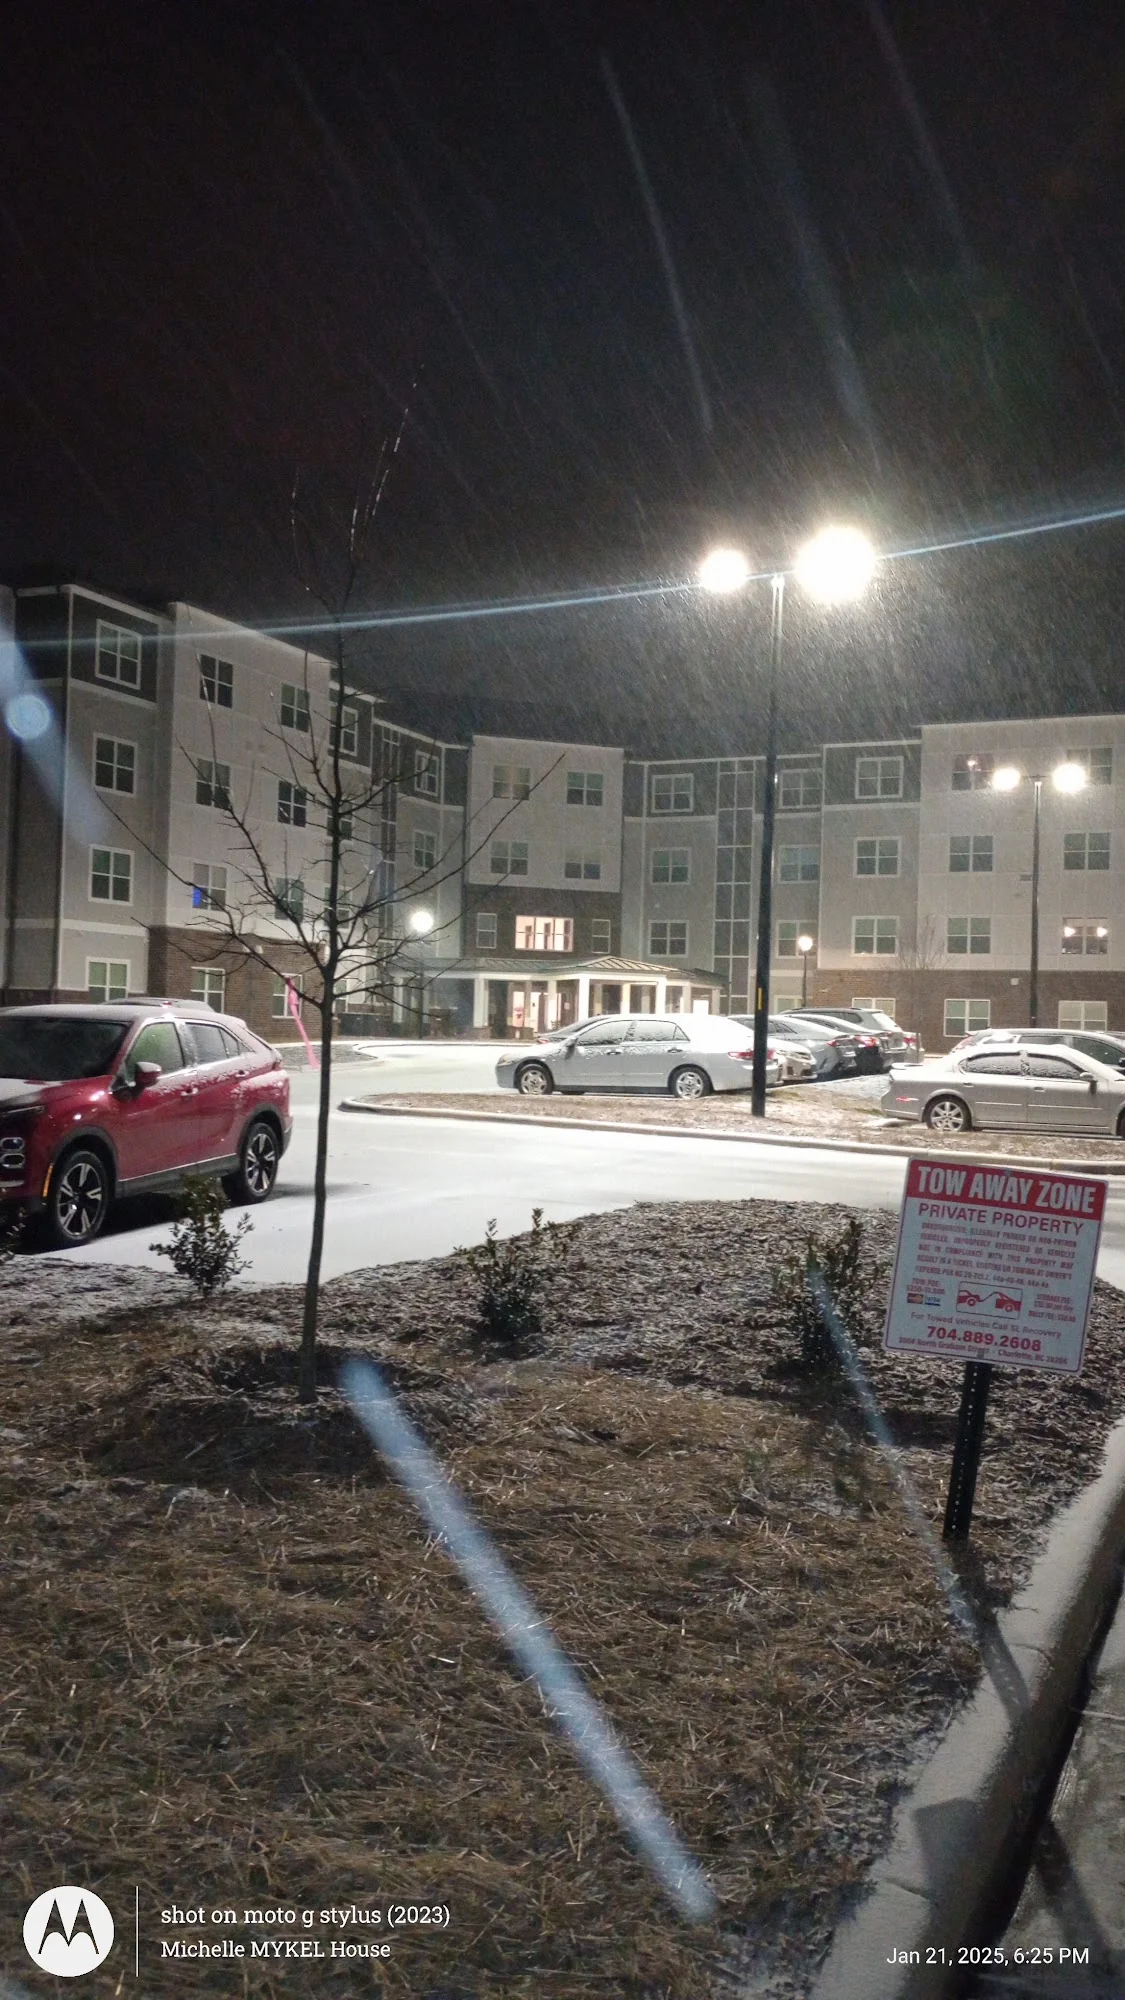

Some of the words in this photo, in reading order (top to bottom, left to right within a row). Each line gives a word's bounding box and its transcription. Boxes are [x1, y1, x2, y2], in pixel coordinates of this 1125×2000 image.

[916, 1166, 966, 1196] TOW
[969, 1172, 1033, 1204] AWAY
[1035, 1180, 1096, 1213] ZONE
[918, 1203, 987, 1222] PRIVATE
[992, 1211, 1083, 1235] PROPERTY
[926, 1326, 1041, 1351] 704.889.2608
[927, 1314, 953, 1323] Towed
[992, 1322, 1007, 1330] Call
[1022, 1326, 1062, 1339] Recovery
